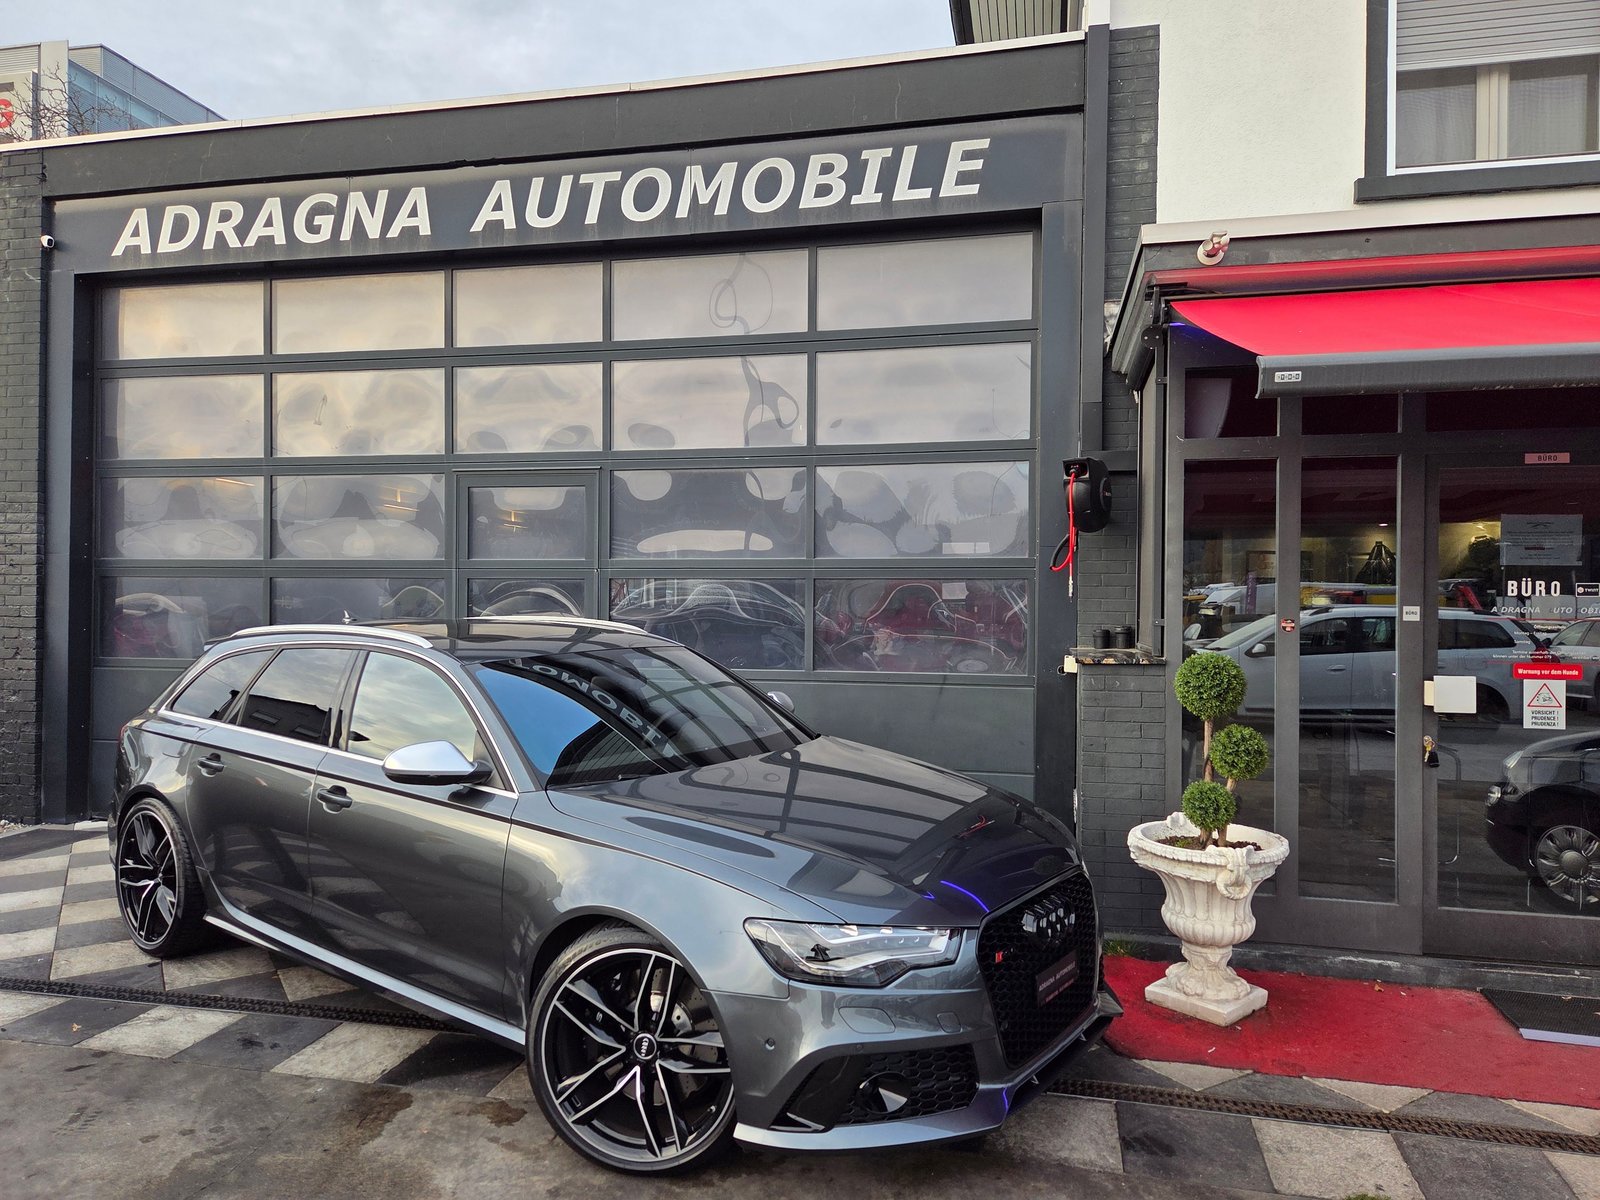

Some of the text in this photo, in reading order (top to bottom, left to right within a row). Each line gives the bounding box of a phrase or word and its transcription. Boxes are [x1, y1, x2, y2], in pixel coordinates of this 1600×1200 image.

[111, 138, 991, 257] ADRAGNA AUTOMOBILE
[1537, 454, 1558, 462] BÜRO
[1507, 577, 1561, 597] BÜRO
[1518, 668, 1541, 676] Warnung
